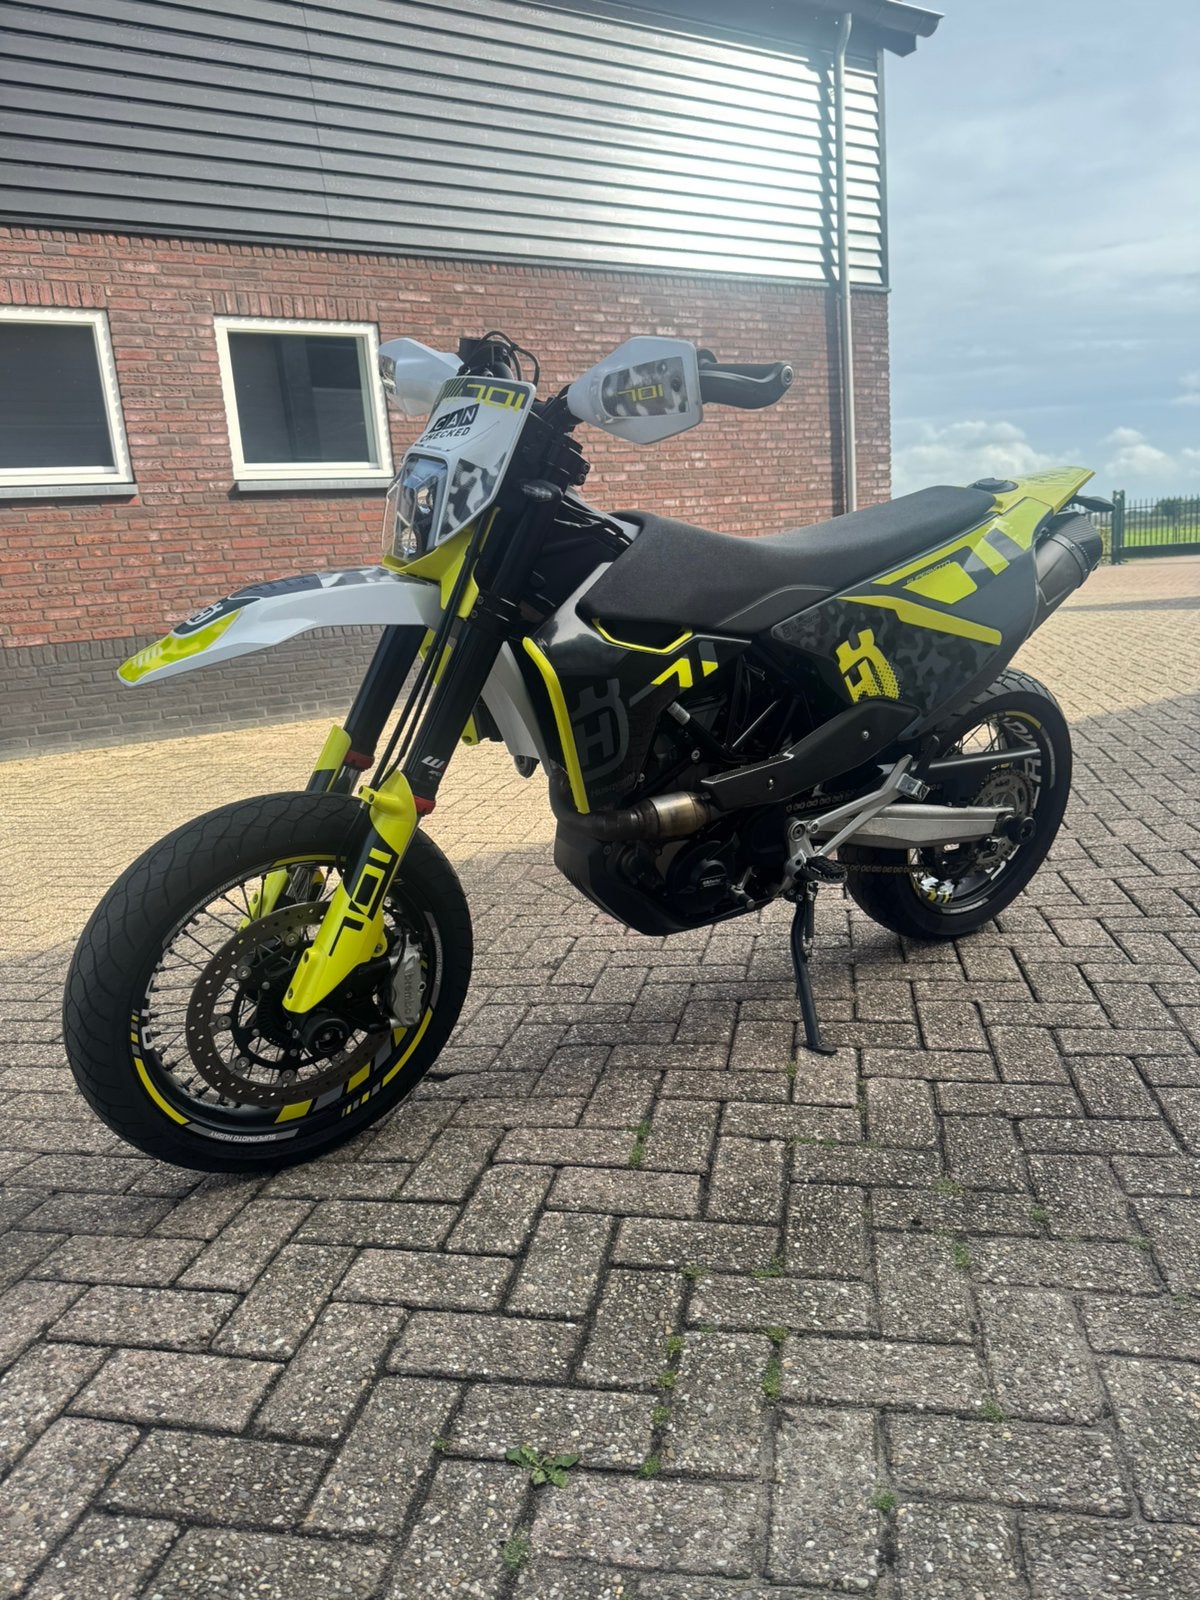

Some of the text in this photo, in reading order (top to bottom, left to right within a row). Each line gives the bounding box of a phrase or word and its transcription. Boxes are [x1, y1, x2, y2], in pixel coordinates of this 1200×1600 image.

[467, 383, 525, 412] 701
[616, 384, 664, 402] 701
[433, 406, 477, 430] CAN
[420, 426, 471, 442] CHECKED
[328, 847, 392, 957] 701
[403, 971, 415, 1015] brembo
[209, 1131, 277, 1143] SUPERMOTO HUSKY
